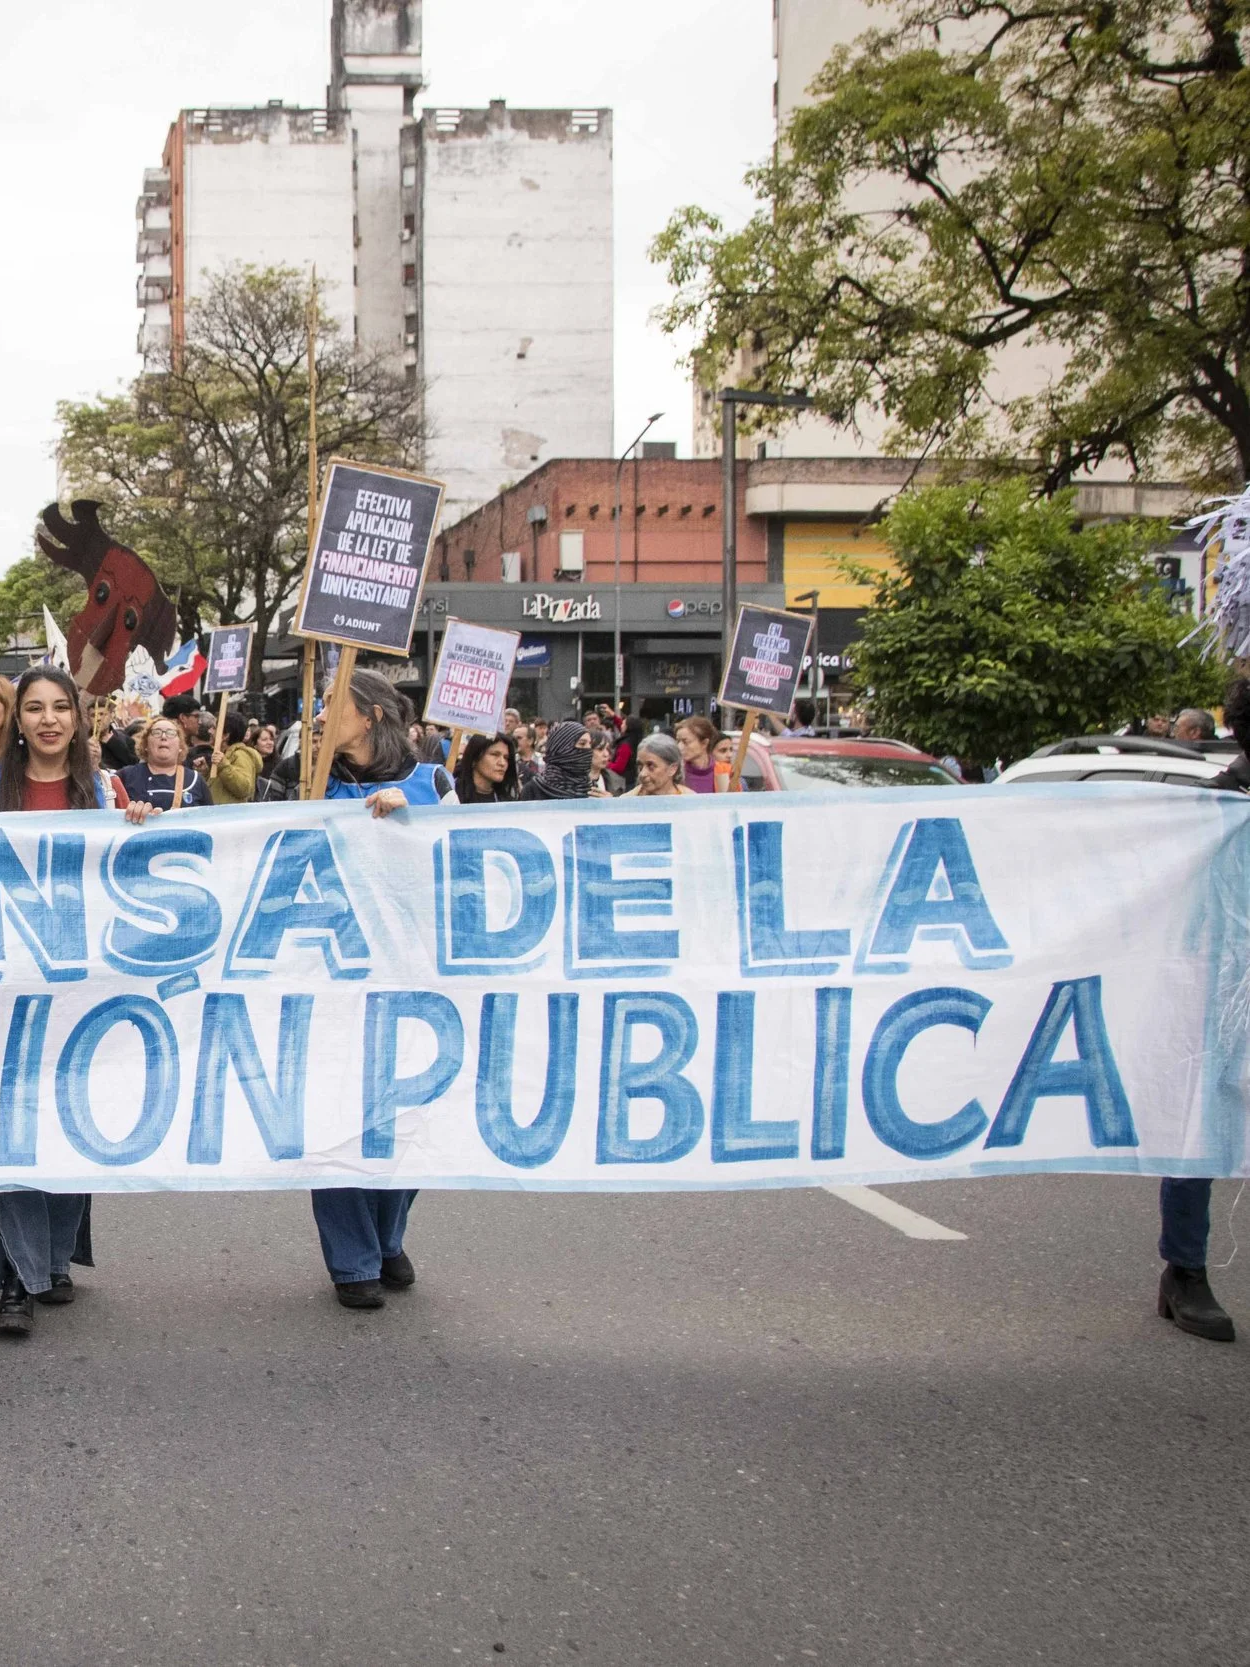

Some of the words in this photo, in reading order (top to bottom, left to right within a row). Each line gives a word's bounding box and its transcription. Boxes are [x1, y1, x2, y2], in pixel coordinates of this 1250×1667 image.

[355, 489, 412, 519] EFECTIVA
[337, 531, 354, 552] DE
[355, 536, 370, 556] LA
[371, 539, 396, 561] LEY
[395, 544, 412, 564] DE
[319, 550, 418, 588] FINANCIAMIENTO
[320, 574, 411, 609] UNIVERSITARIO
[345, 619, 381, 632] ADIUNT
[448, 663, 496, 692] HUELGA
[741, 658, 791, 678] UNIVERSIDAD
[439, 683, 495, 714] GENERAL
[433, 822, 680, 980] DE
[733, 817, 1013, 977] LA
[362, 975, 1139, 1169] PUBLICA
